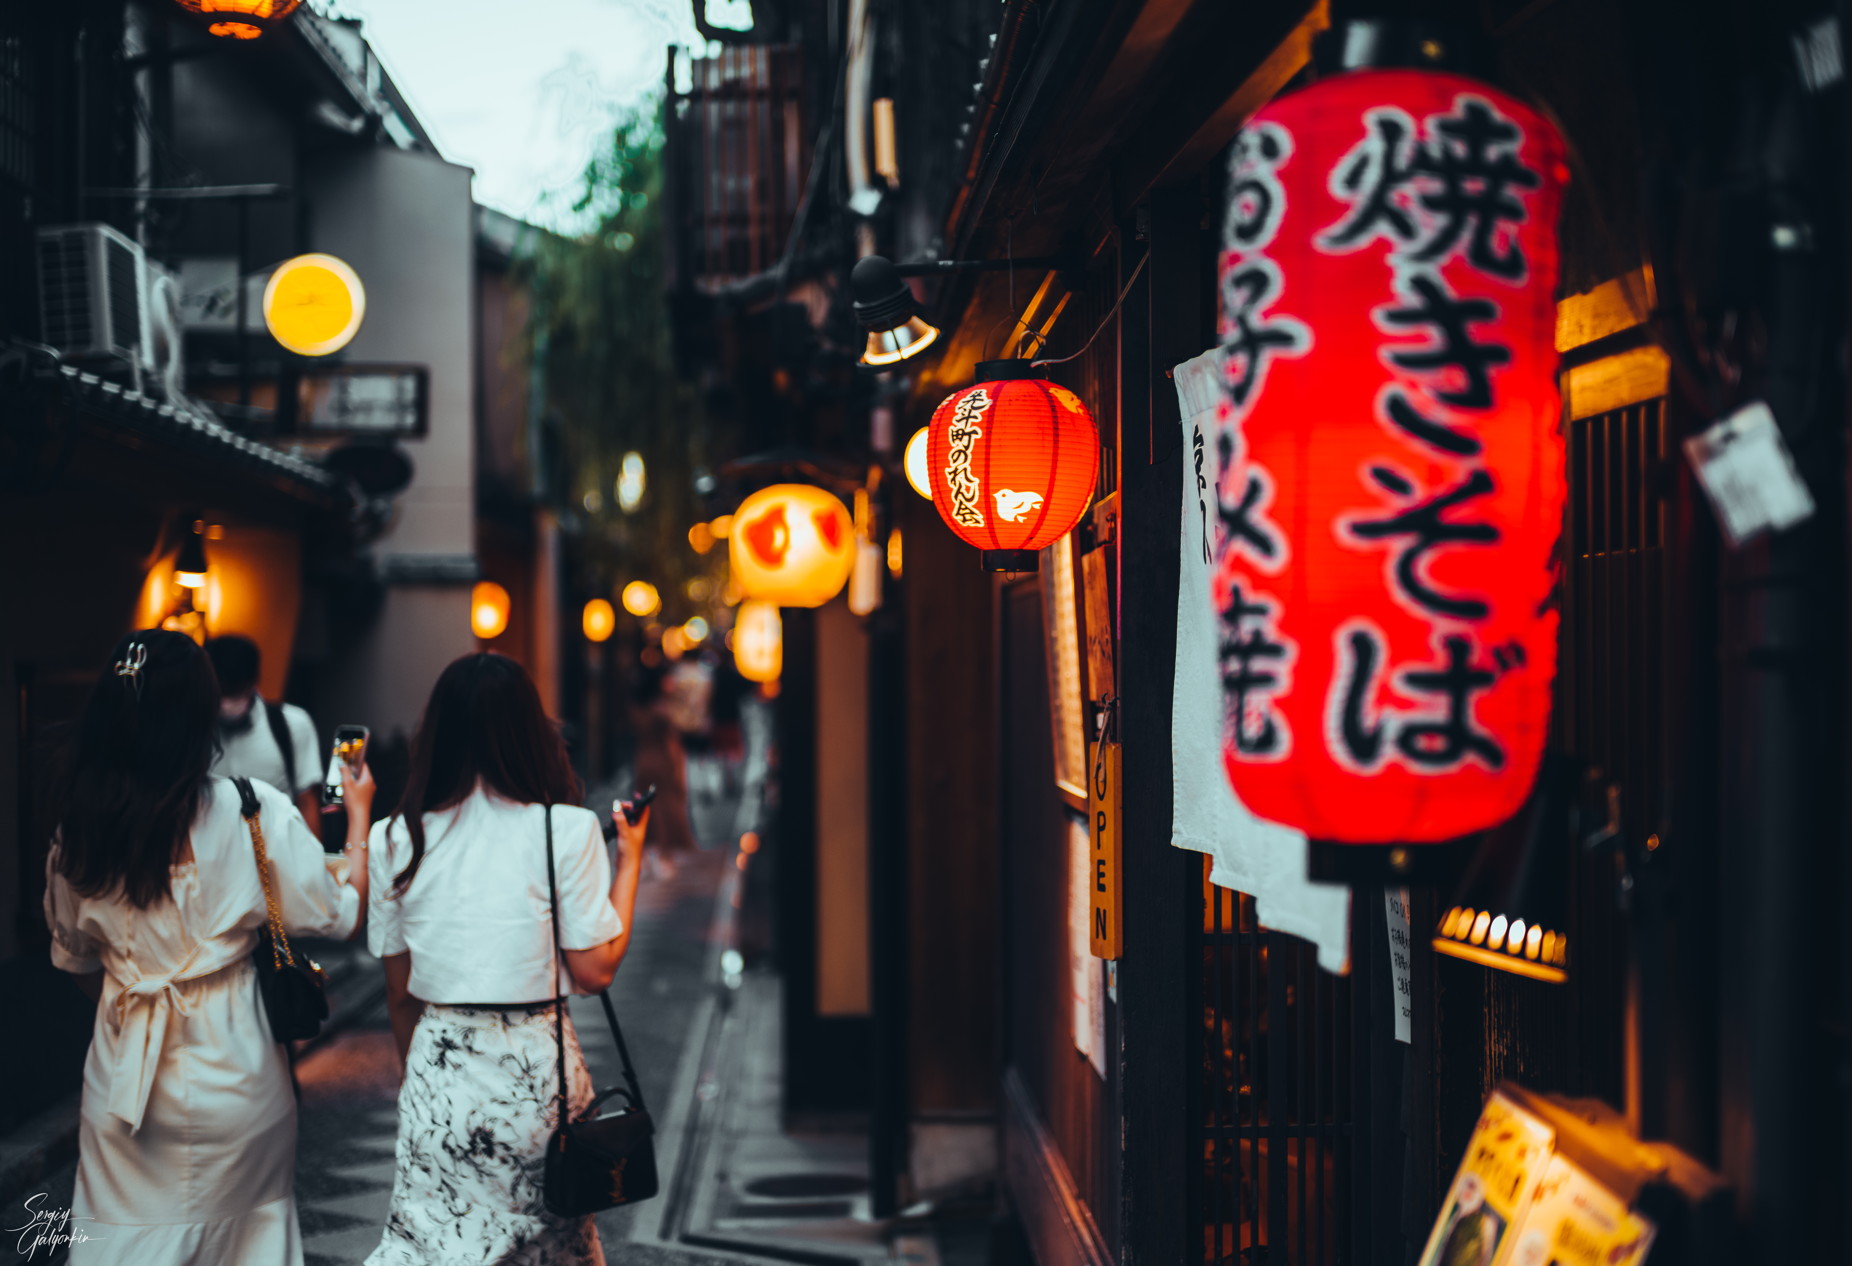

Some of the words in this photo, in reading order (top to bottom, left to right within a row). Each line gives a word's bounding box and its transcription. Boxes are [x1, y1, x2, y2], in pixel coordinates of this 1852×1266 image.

[1312, 93, 1544, 773] 焼きそば
[1094, 761, 1108, 941] OPEN
